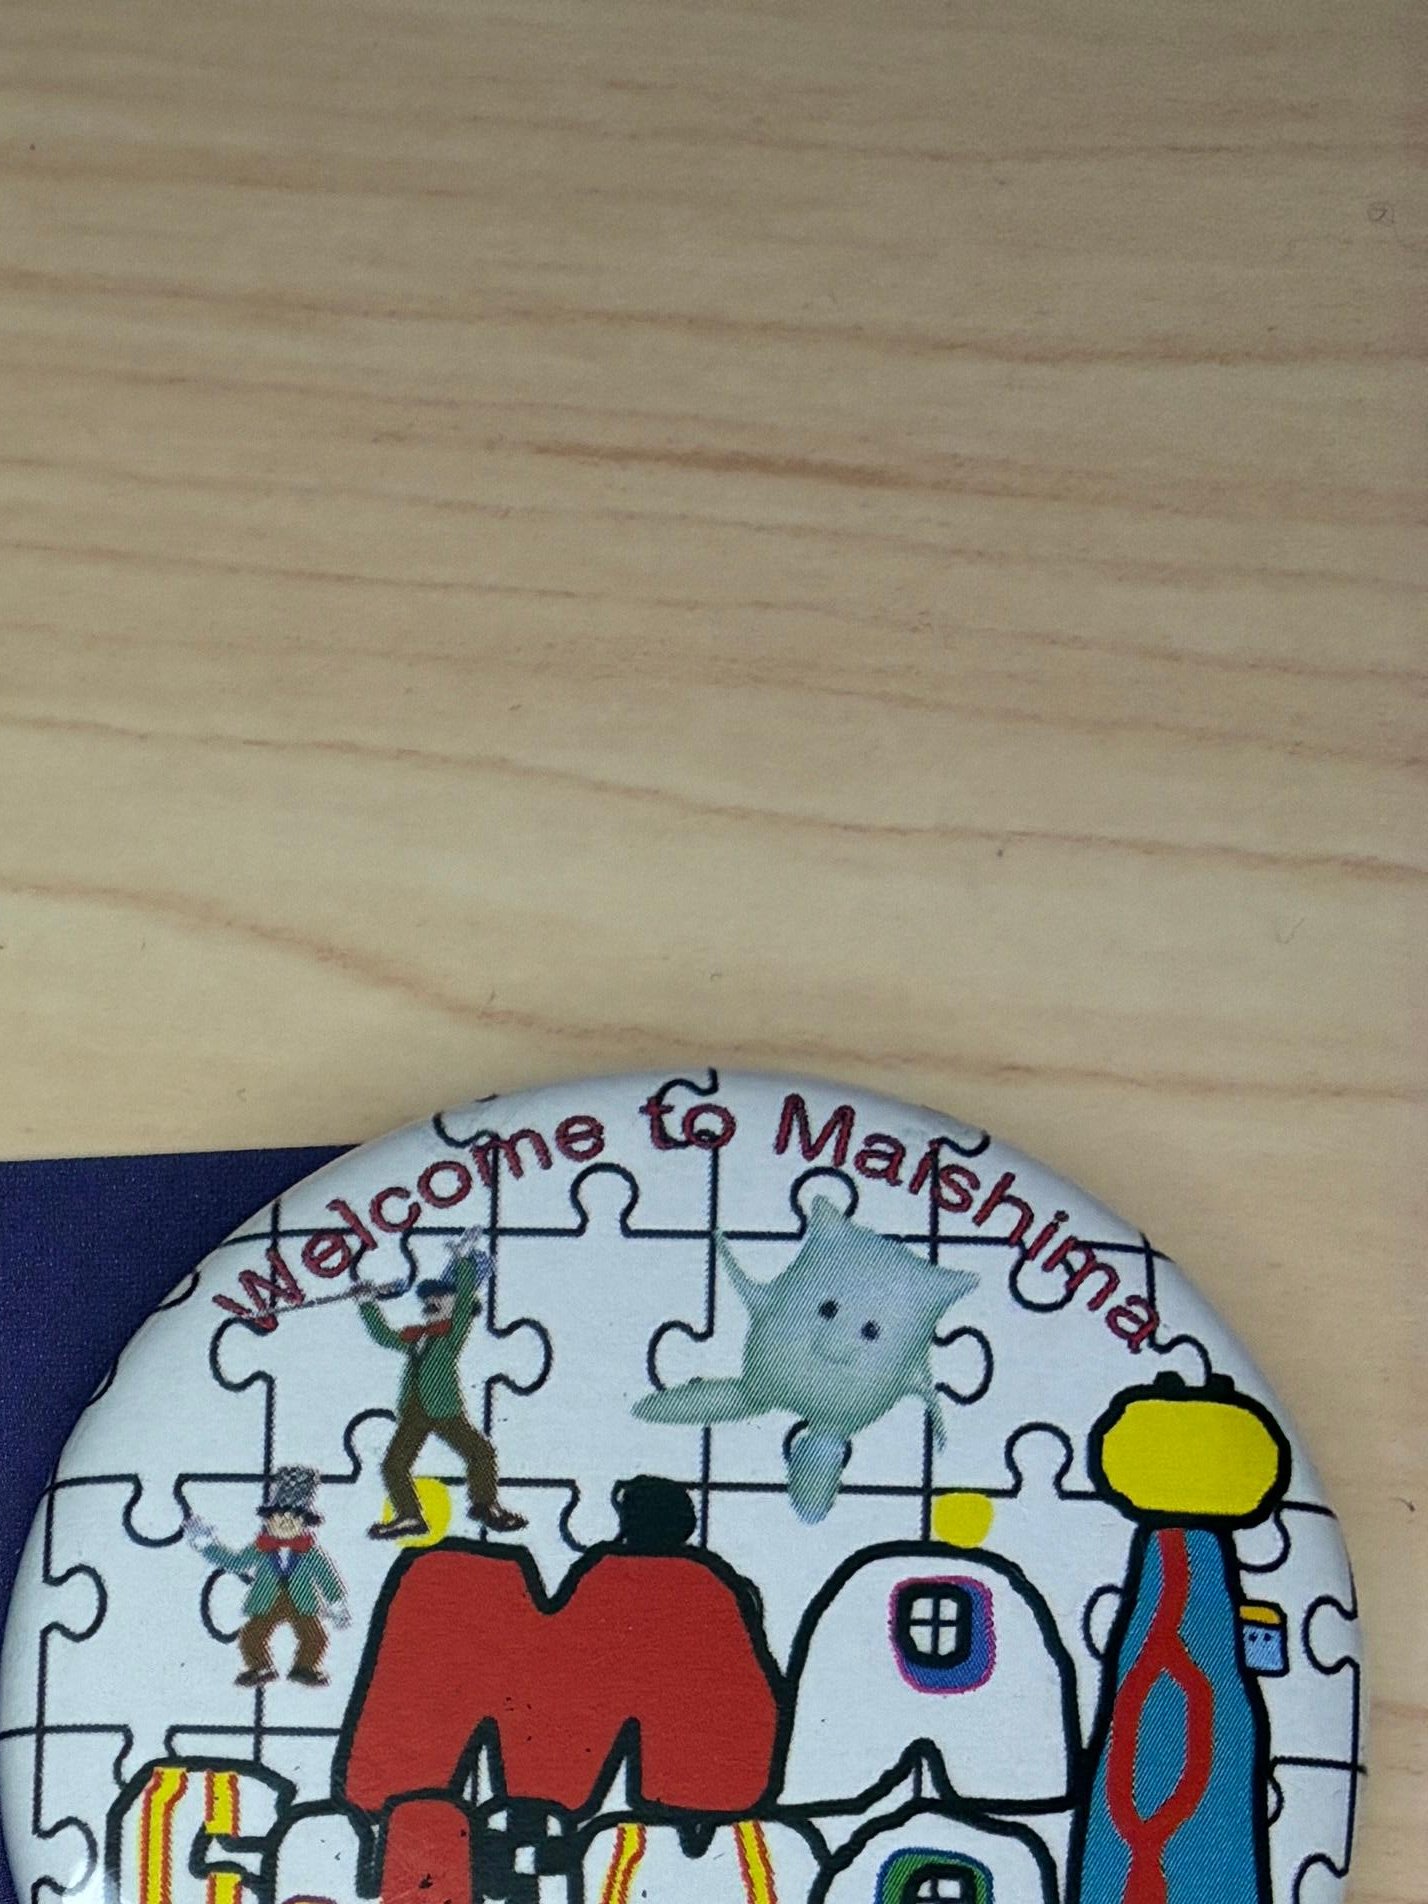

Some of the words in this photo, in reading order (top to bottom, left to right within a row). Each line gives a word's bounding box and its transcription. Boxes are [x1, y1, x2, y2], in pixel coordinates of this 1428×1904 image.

[211, 1112, 606, 1334] Welcome
[637, 1094, 737, 1152] to
[773, 1093, 1162, 1354] Maishima
